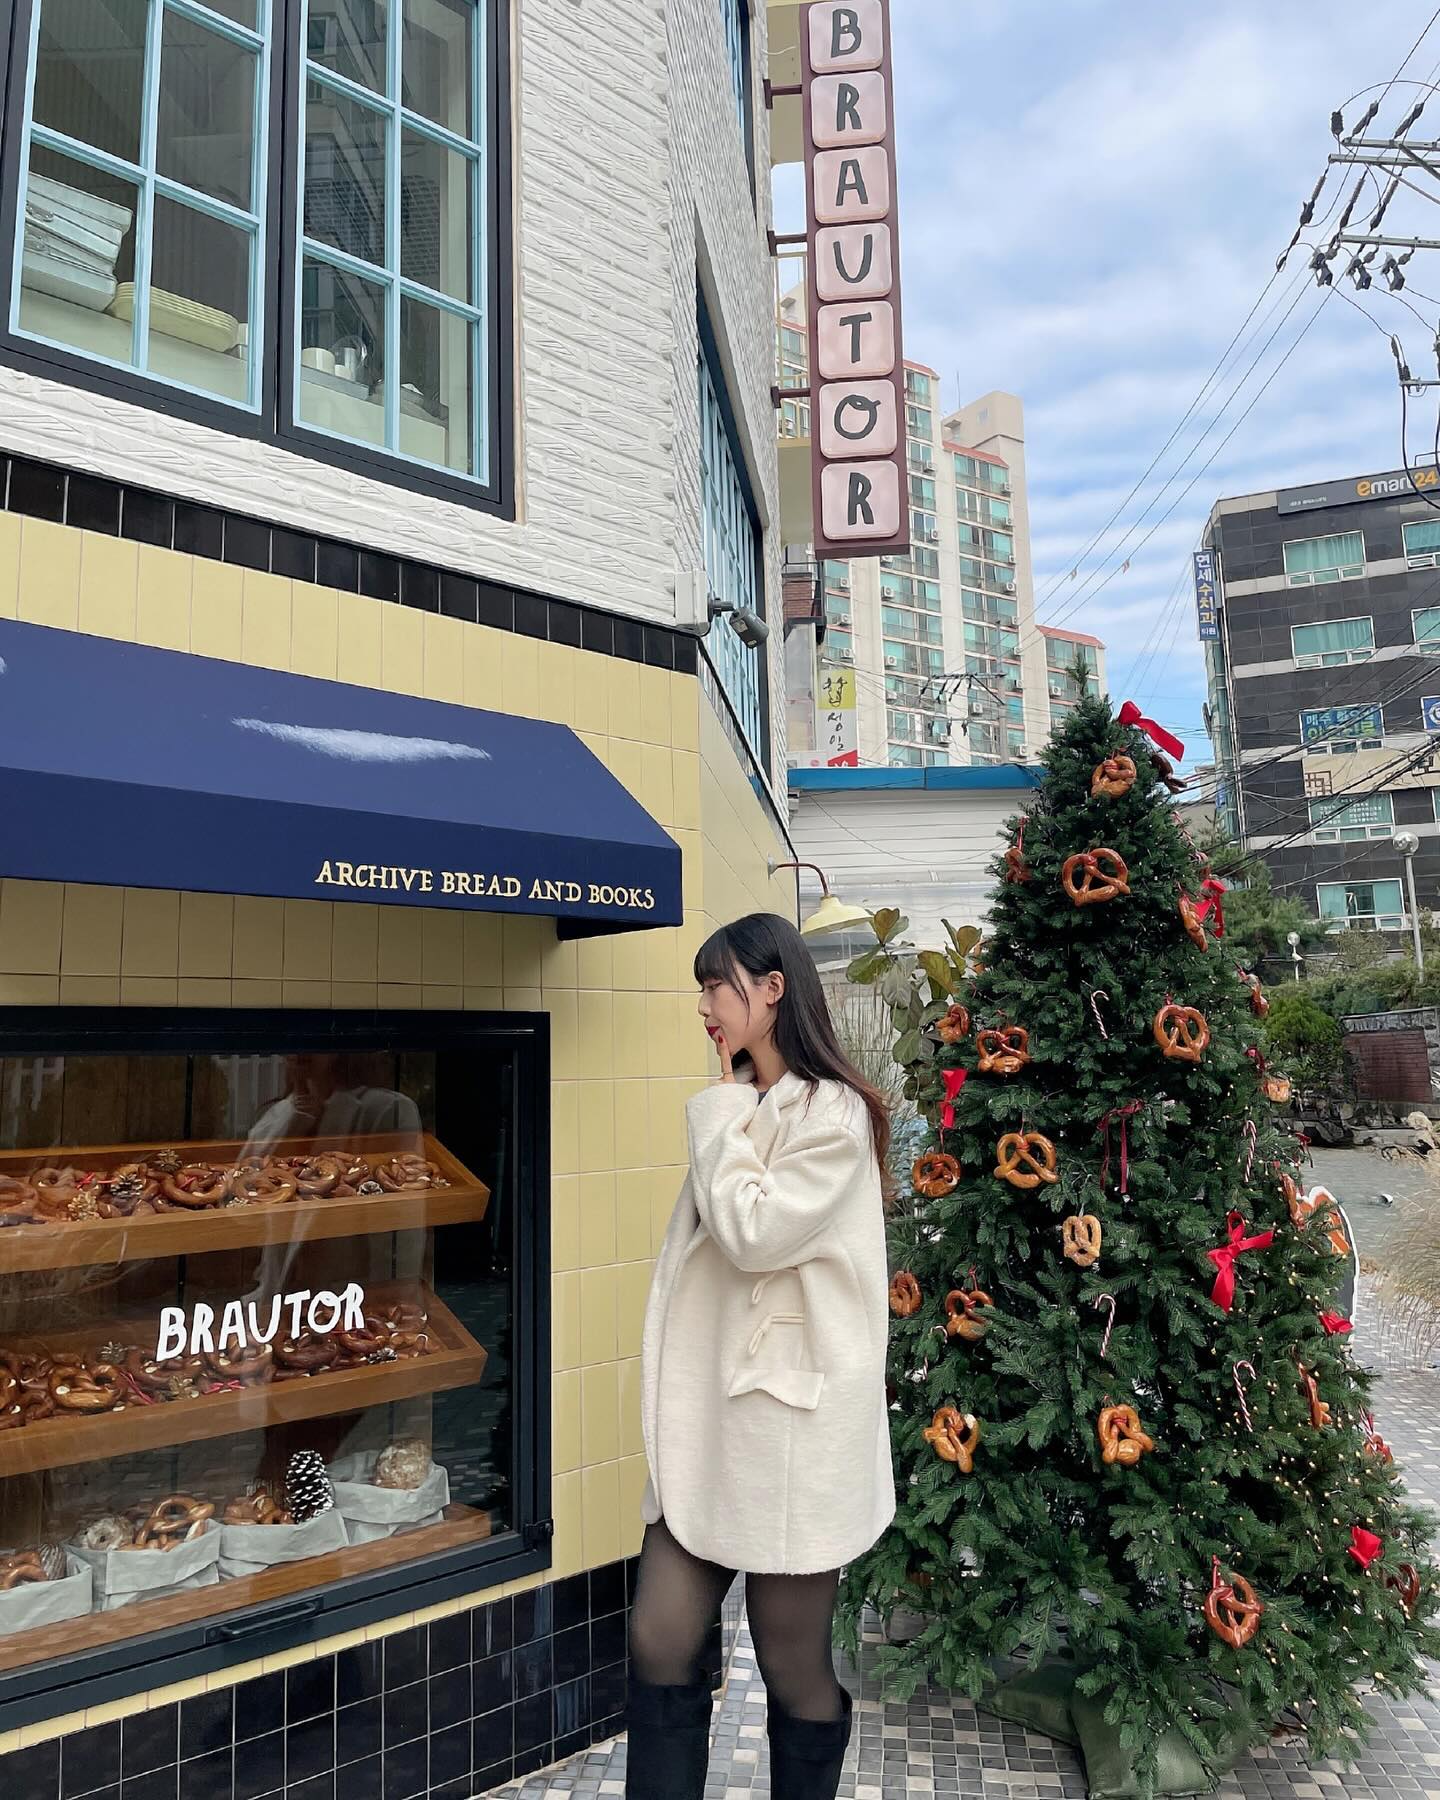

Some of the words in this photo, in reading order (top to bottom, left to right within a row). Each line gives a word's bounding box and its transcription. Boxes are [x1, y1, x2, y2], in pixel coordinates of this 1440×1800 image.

[831, 8, 881, 525] BRAUTOR
[1306, 712, 1331, 726] 매주
[315, 860, 433, 892] ARCHIVE
[440, 871, 521, 898] BREAD
[528, 878, 583, 902] AND
[588, 884, 655, 909] BOOKS
[156, 1283, 365, 1362] BRAUTOR
